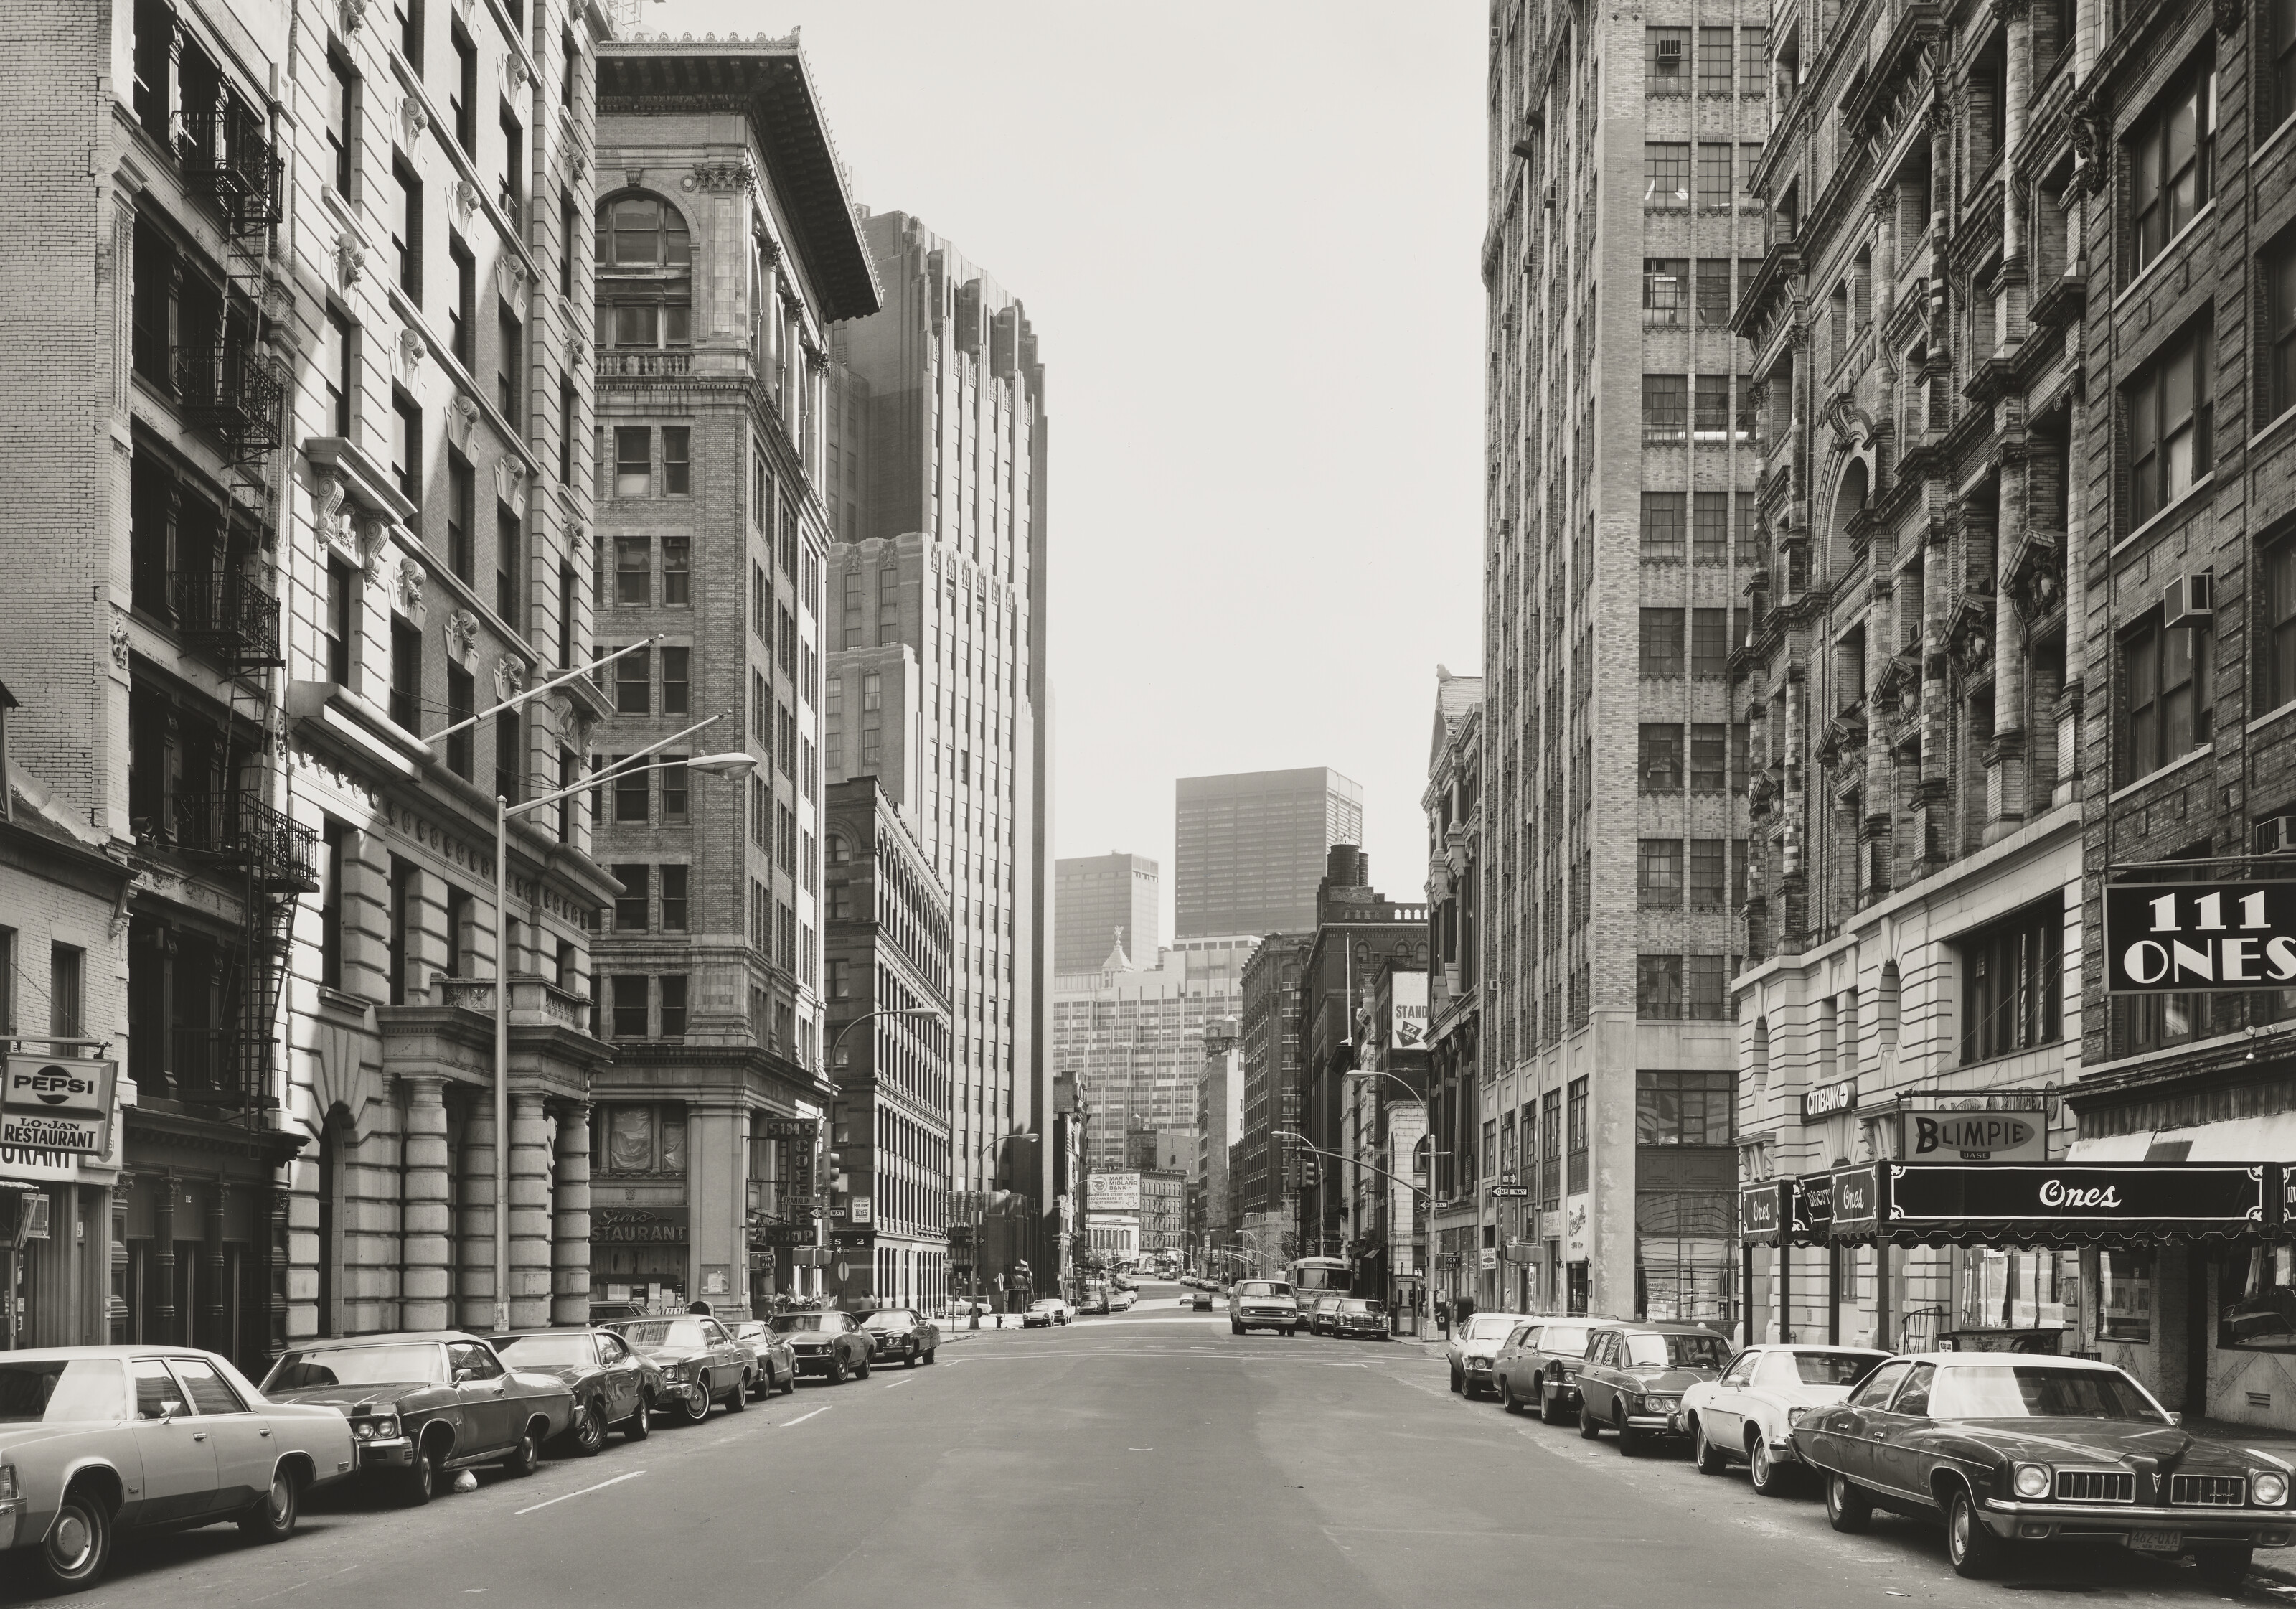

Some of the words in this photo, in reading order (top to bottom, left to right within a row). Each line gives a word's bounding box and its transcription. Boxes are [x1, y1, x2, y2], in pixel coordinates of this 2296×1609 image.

[2149, 890, 2271, 932] 111
[2124, 936, 2296, 984] ONES
[14, 1075, 94, 1094] PEPSI
[1807, 1085, 1840, 1115] CITIBANK
[4, 1124, 96, 1148] RESTAURANT
[20, 1118, 80, 1131] LO-JAN
[768, 1120, 814, 1135] SIM'S
[1915, 1117, 2024, 1154] BLIMPIE
[1843, 1184, 1864, 1209] Ones
[2039, 1179, 2122, 1208] Ones
[1753, 1201, 1771, 1222] Ones
